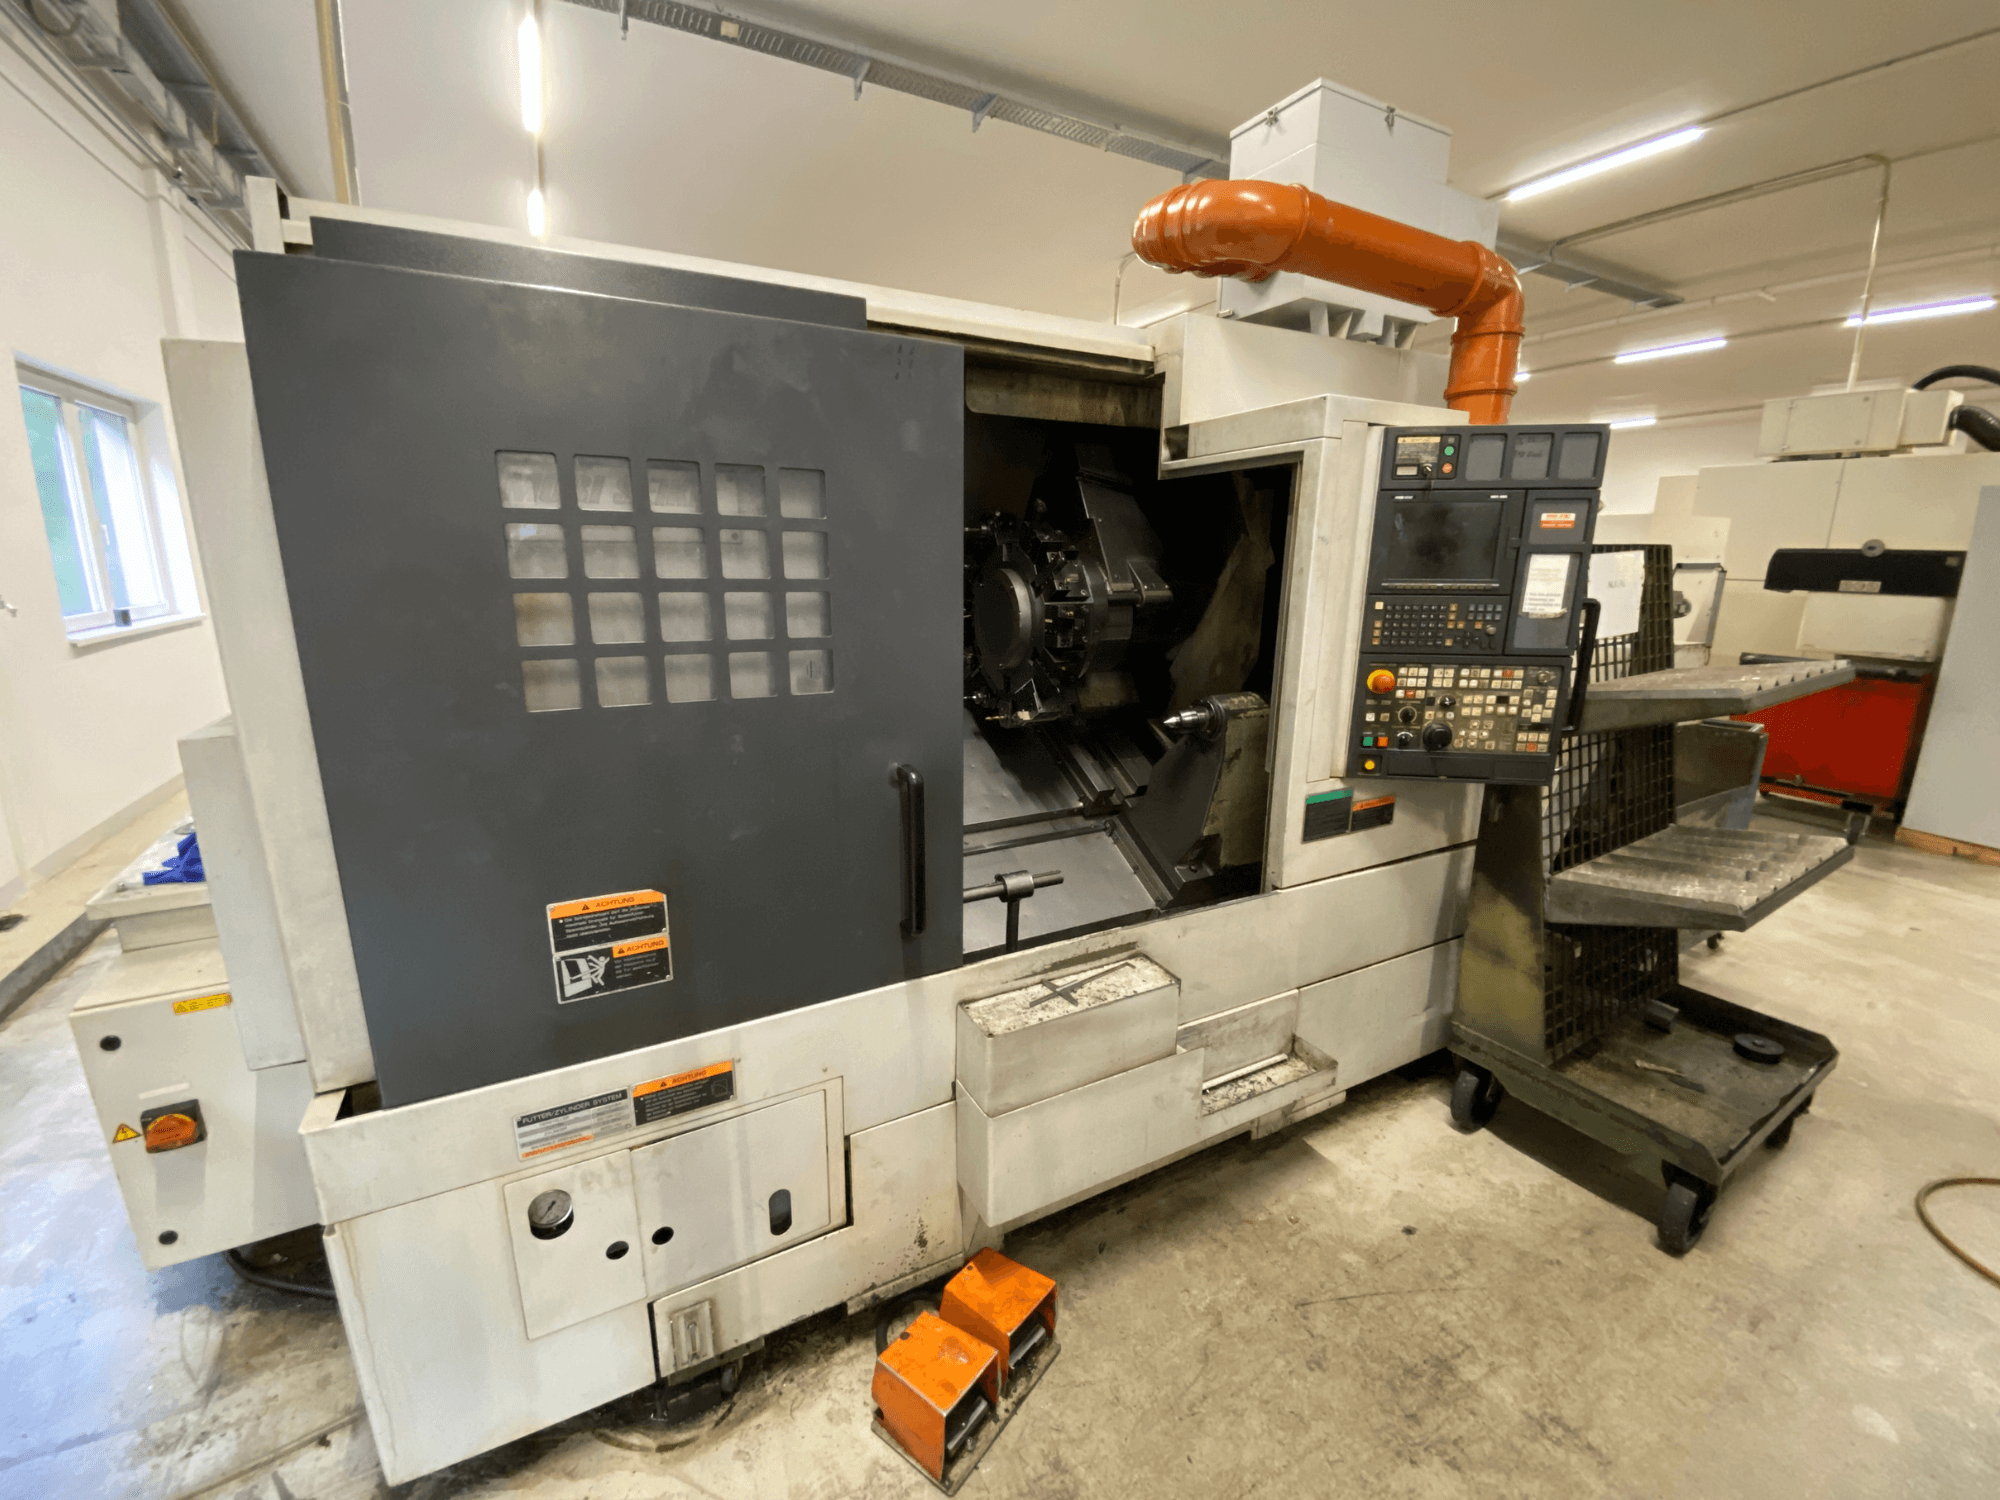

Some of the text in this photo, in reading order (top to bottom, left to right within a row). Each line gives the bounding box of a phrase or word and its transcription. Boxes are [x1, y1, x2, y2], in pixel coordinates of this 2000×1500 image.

[596, 896, 635, 908] ACHTUNG
[626, 939, 664, 952] ACHTUNG
[522, 1101, 591, 1124] FUTTER/ZYLINDER
[592, 1092, 623, 1106] SYSTEM
